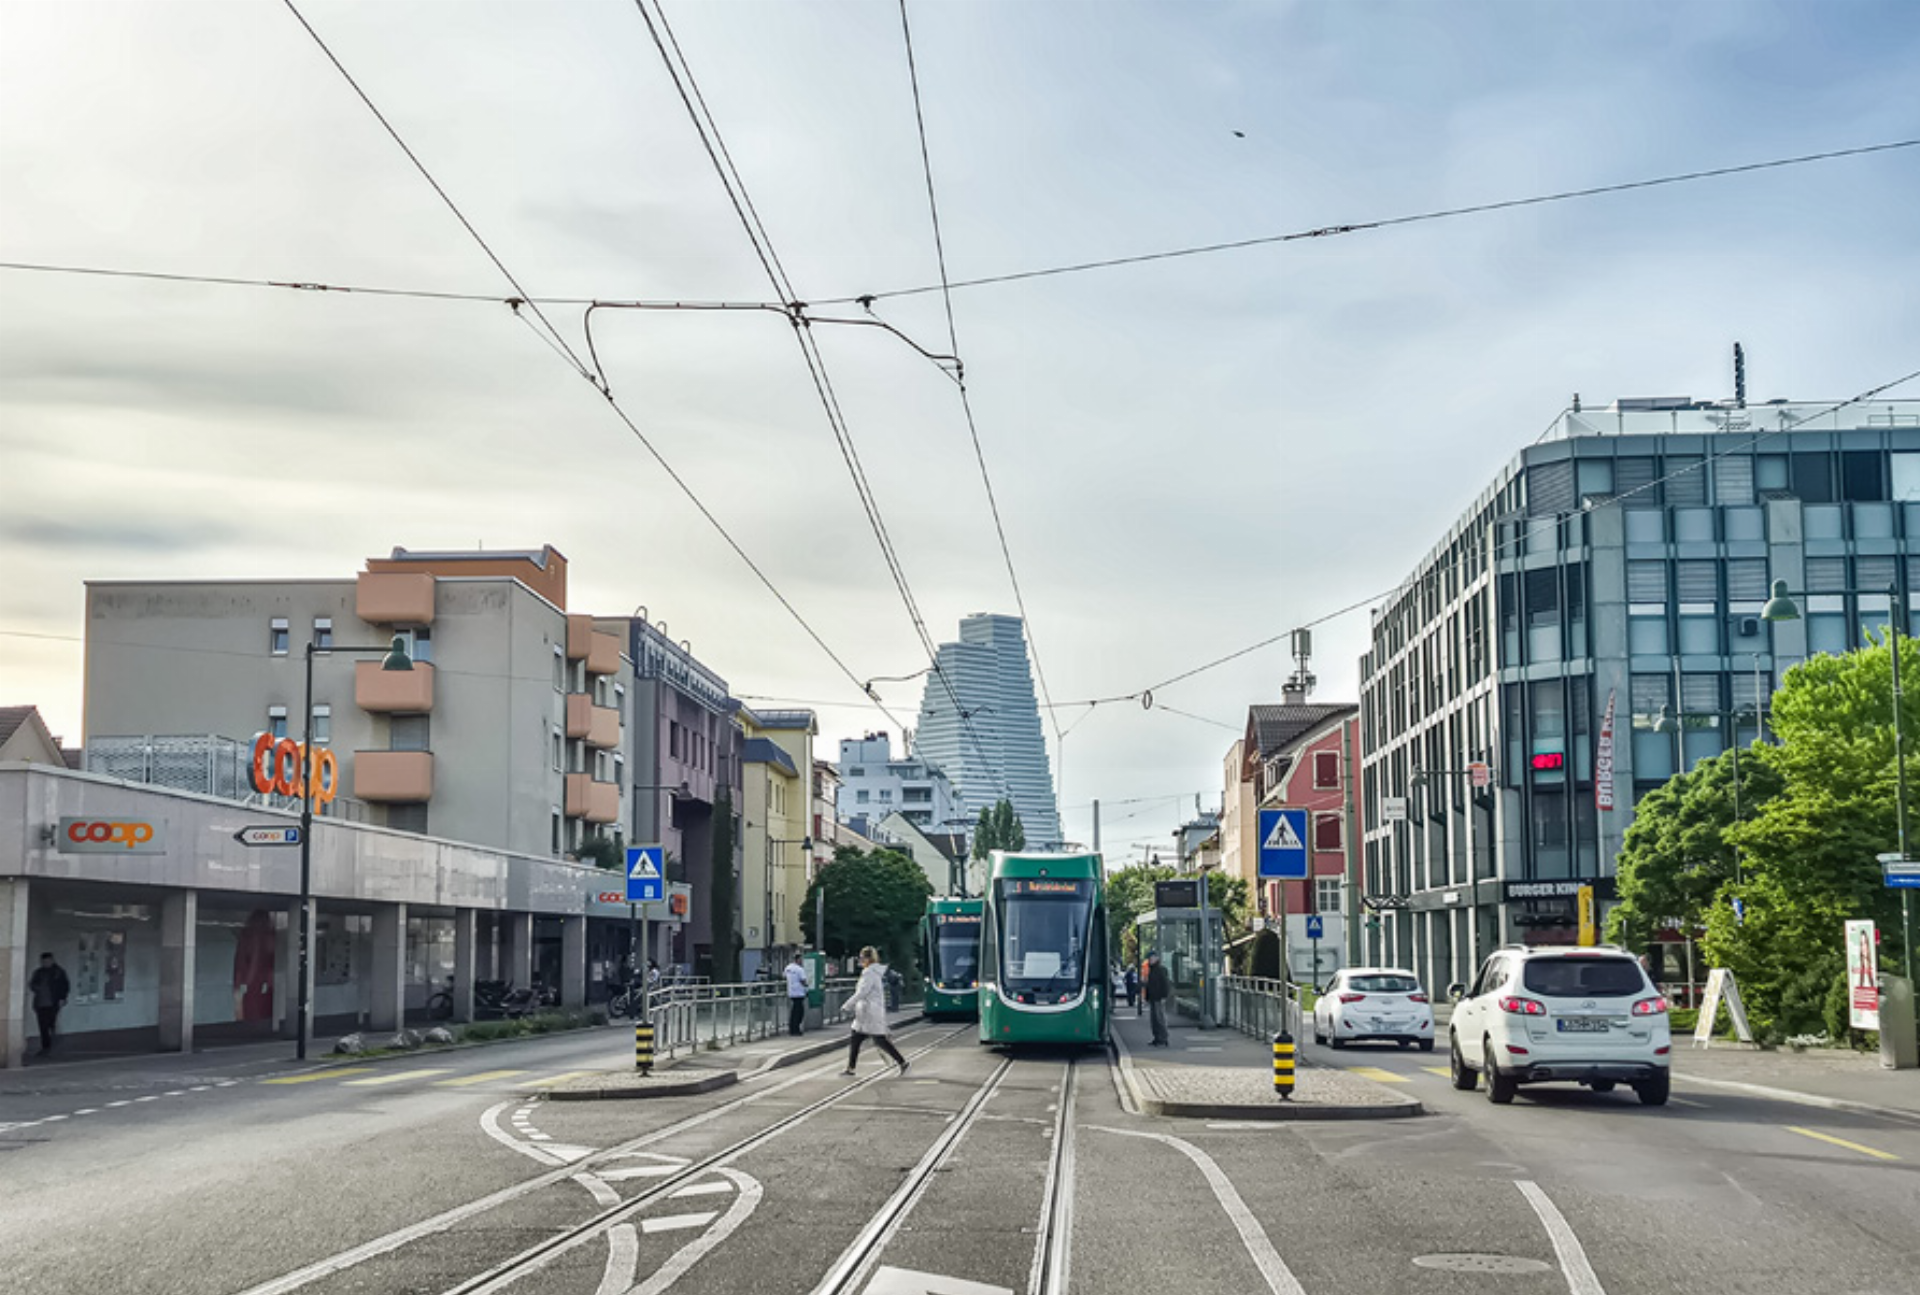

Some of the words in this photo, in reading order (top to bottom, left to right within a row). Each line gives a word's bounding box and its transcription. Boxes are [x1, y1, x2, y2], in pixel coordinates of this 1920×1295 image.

[252, 732, 338, 815] coop
[68, 821, 154, 848] coop
[253, 831, 281, 841] coop
[1508, 882, 1555, 898] BURGER
[1556, 883, 1586, 896] KIN
